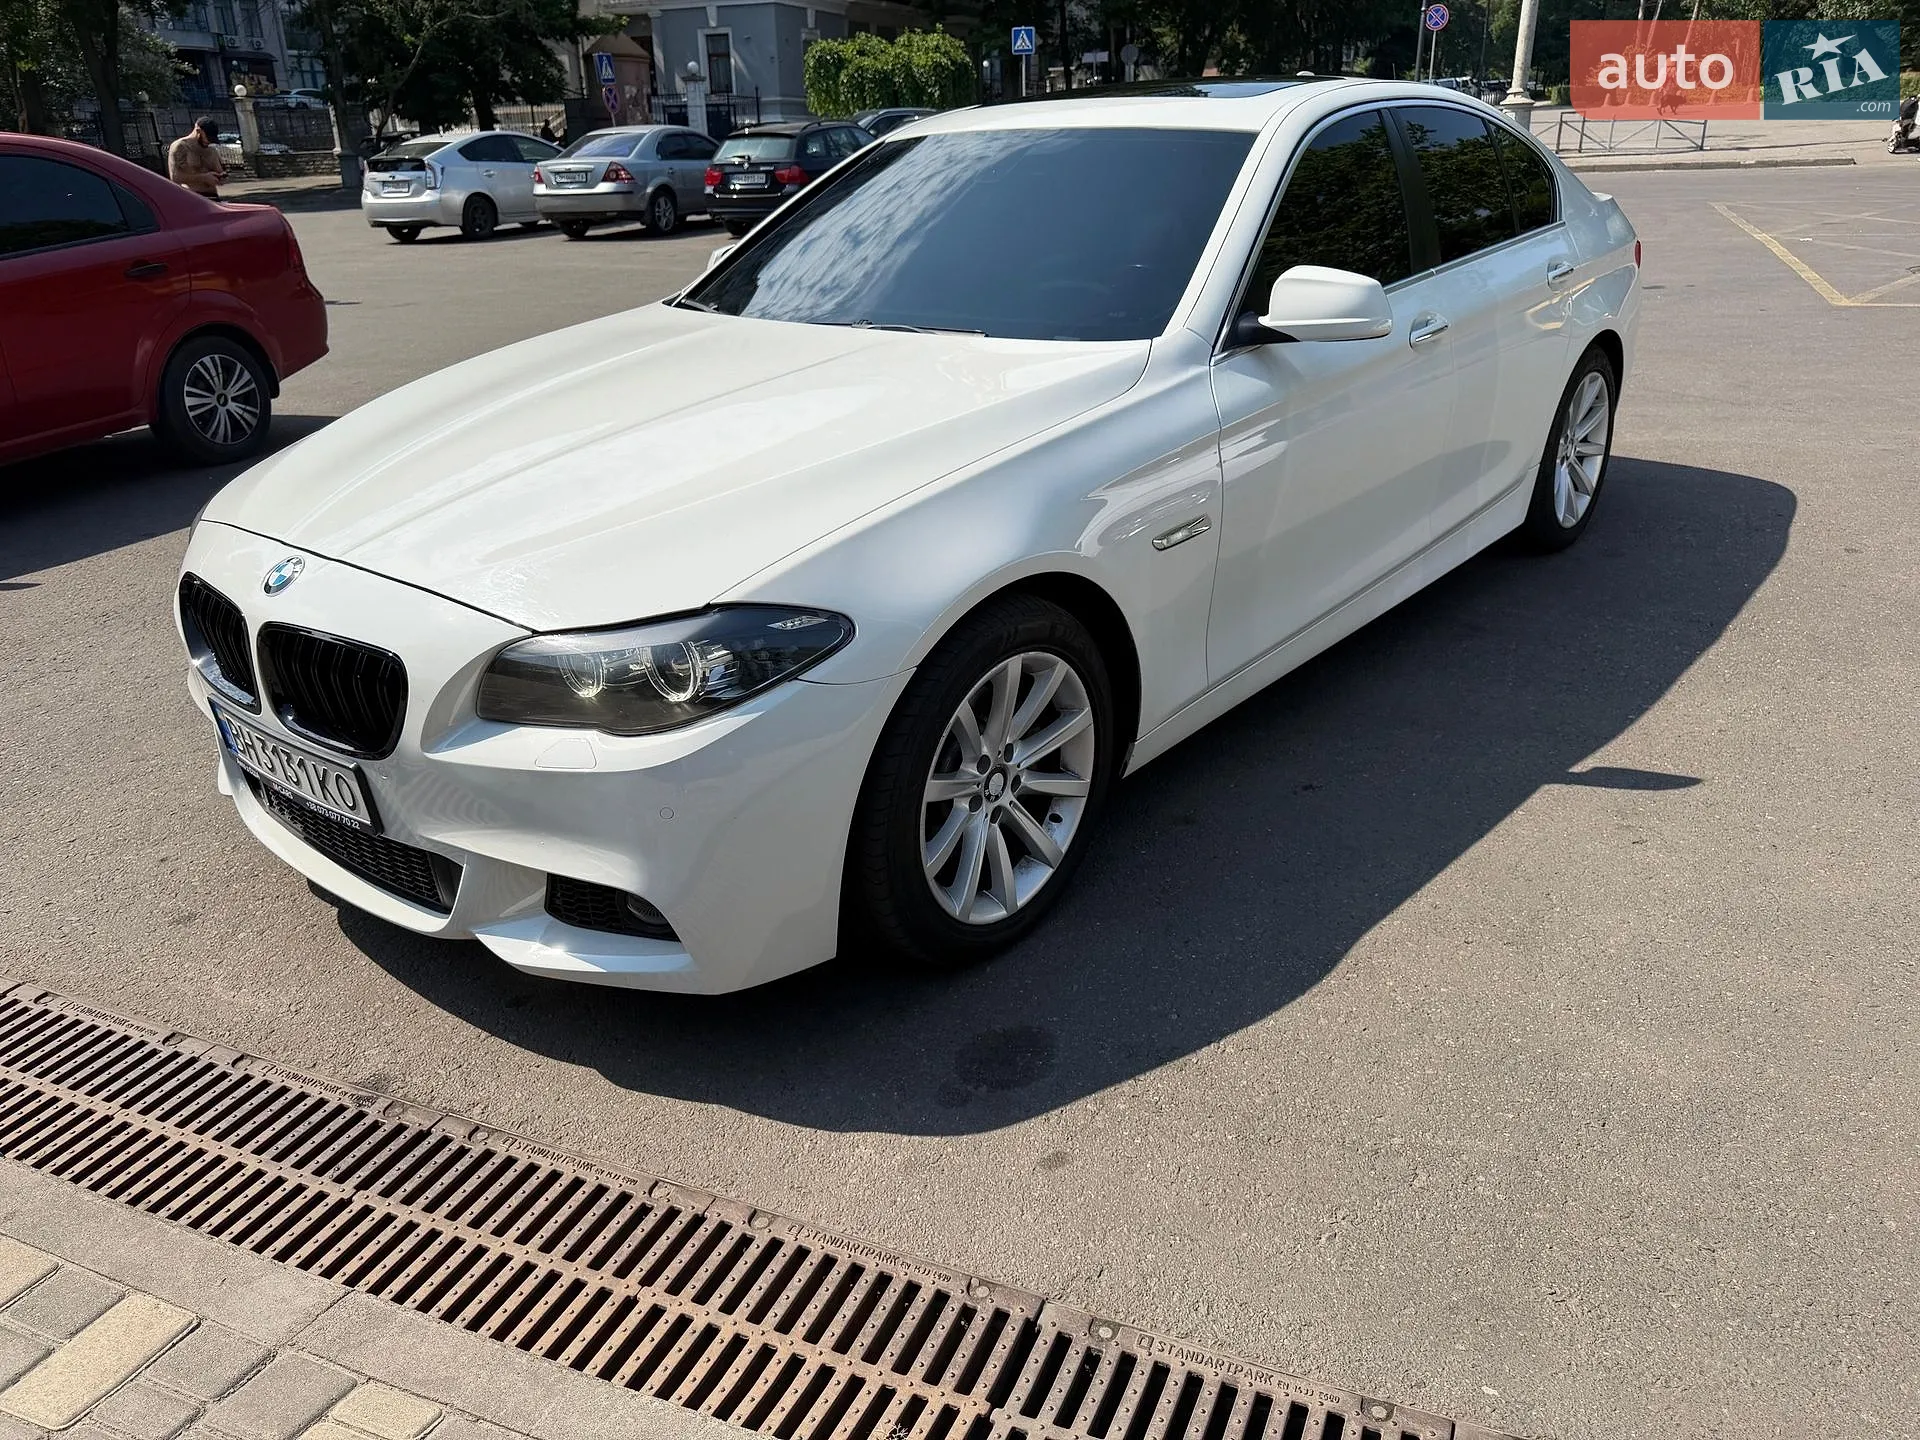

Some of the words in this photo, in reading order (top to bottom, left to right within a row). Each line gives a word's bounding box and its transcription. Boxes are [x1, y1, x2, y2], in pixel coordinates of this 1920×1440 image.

[351, 820, 361, 830] 22
[515, 1140, 596, 1172] STANDARTPARK
[803, 1227, 900, 1266] STANDARTPARK
[1157, 1340, 1275, 1387] STANDARTPARK
[1277, 1380, 1290, 1390] EN
